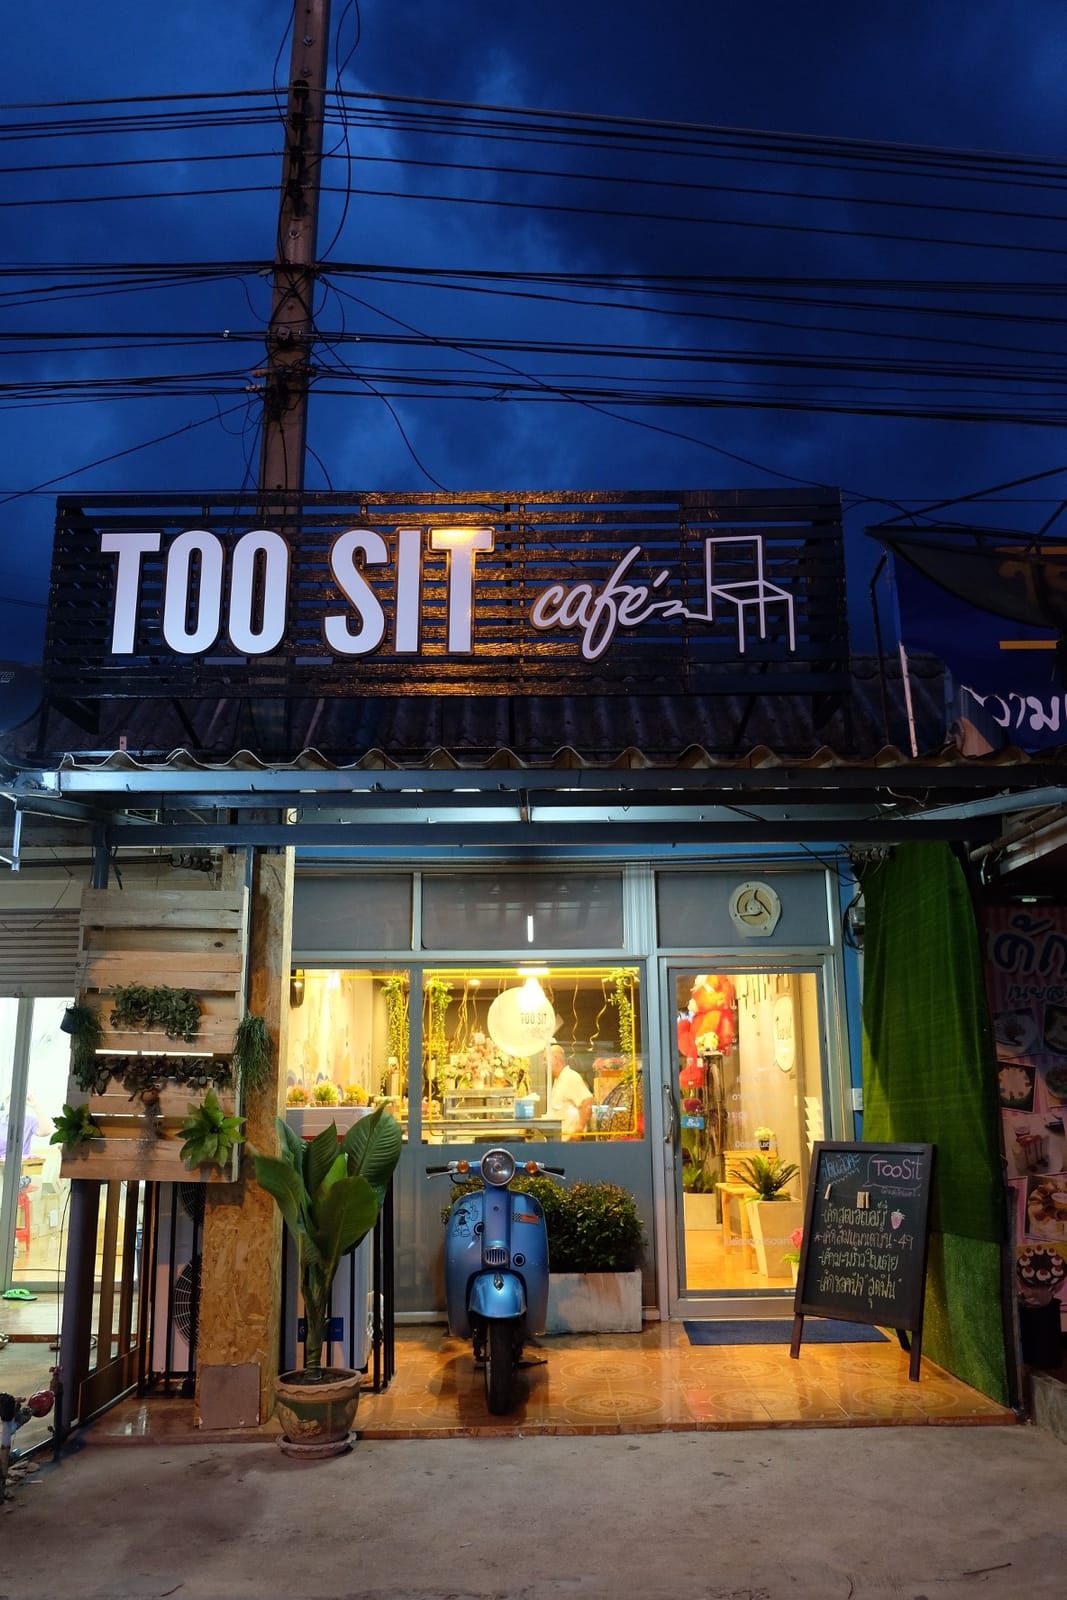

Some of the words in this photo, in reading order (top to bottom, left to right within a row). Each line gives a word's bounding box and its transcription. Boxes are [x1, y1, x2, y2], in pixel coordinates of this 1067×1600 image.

[100, 530, 288, 654] TOO
[324, 529, 493, 654] SIT
[533, 546, 669, 659] café
